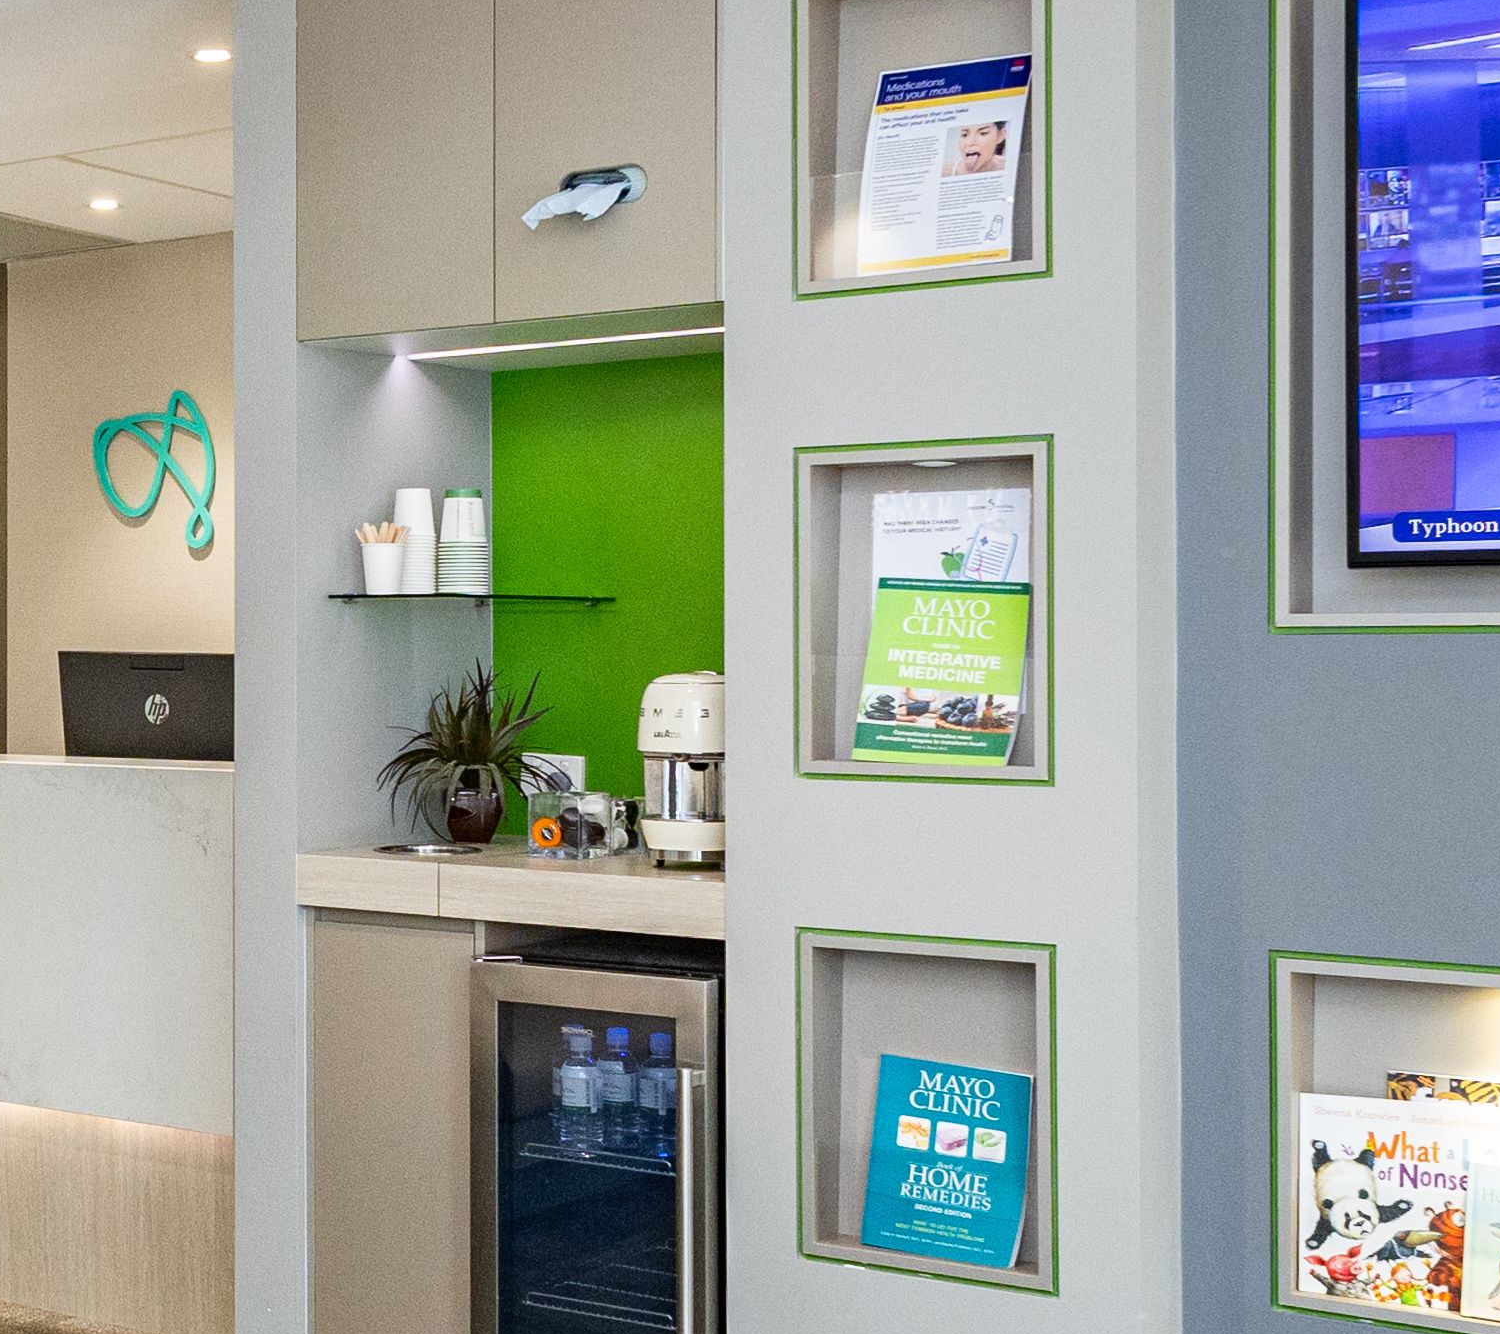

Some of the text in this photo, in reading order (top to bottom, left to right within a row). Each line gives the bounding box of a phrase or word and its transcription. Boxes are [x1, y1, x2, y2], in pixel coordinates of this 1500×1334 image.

[884, 84, 963, 103] and your mouth
[886, 77, 946, 93] Medications
[1408, 517, 1499, 539] Typhoon
[911, 596, 991, 620] MAYO
[902, 615, 996, 640] CLINIC
[887, 648, 1002, 670] INTEGRATIVE
[898, 665, 987, 685] MEDICINE
[918, 1069, 996, 1099] MAYO
[908, 1088, 1001, 1121] CLINIC
[1367, 1130, 1441, 1164] What
[907, 1163, 989, 1196] HOME
[1377, 1166, 1395, 1183] of
[900, 1182, 992, 1212] REMEDIES
